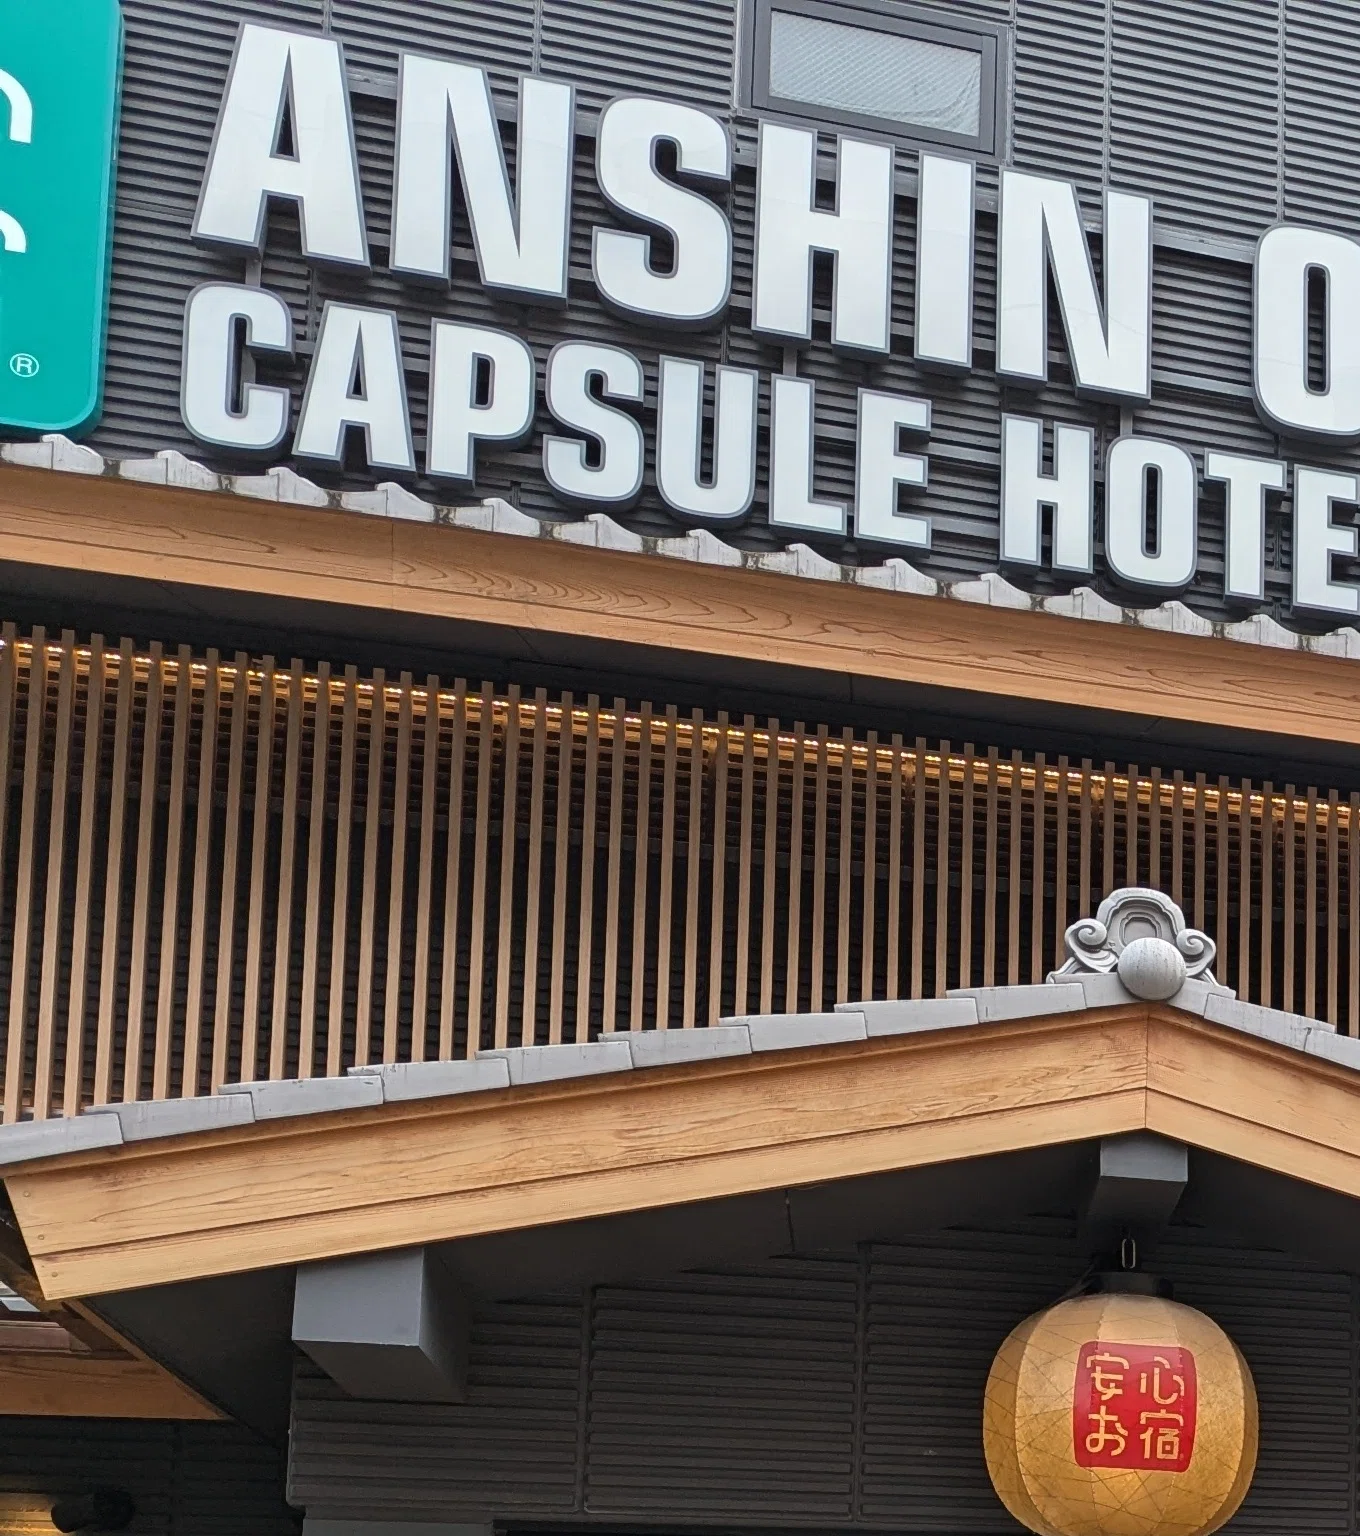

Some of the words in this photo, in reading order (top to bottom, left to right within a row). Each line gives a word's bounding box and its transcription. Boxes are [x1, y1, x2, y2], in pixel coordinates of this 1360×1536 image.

[191, 22, 1152, 403] ANSHIN
[184, 281, 933, 544] CAPSULE
[1086, 1353, 1184, 1404] 安心
[1086, 1406, 1184, 1460] お宿
